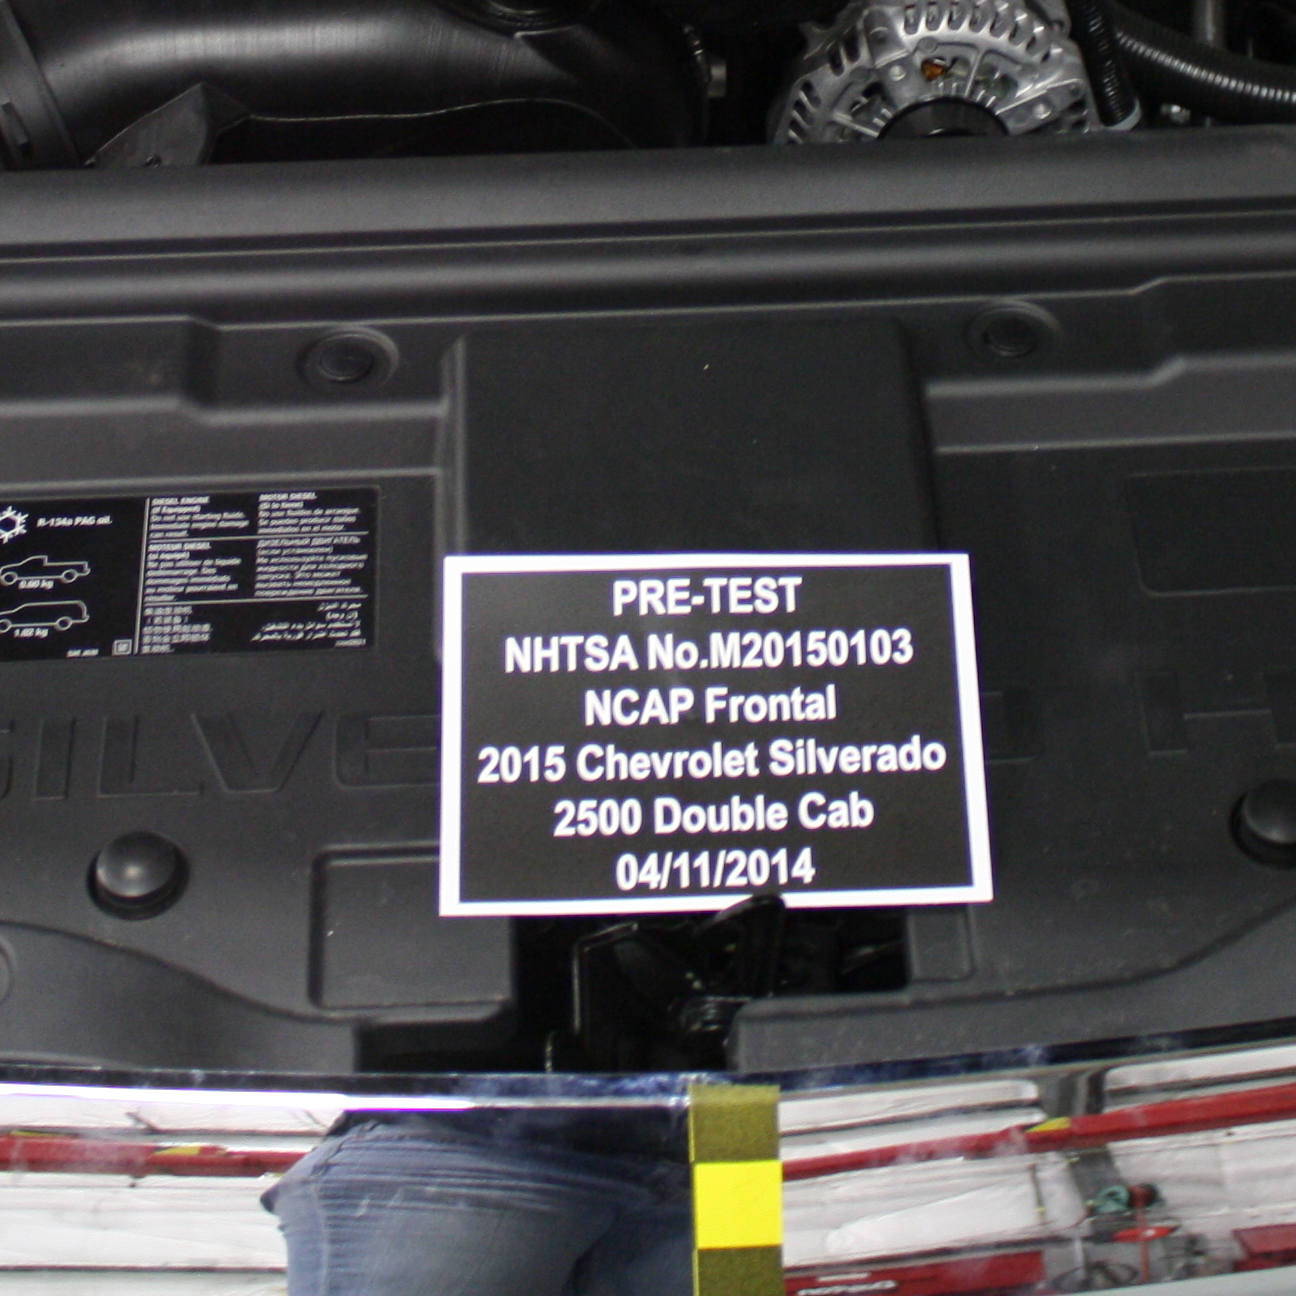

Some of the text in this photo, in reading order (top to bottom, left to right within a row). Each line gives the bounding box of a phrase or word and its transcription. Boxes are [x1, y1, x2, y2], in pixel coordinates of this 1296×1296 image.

[613, 576, 803, 616] PRE-TEST
[505, 628, 914, 673] NHTSA No.M20150103
[585, 684, 836, 726] NCAP Frontal
[478, 735, 947, 784] 2015 Chevrolet Silverado
[554, 791, 875, 836] 2500 Double Cab
[616, 847, 816, 891] 04/11/2014
